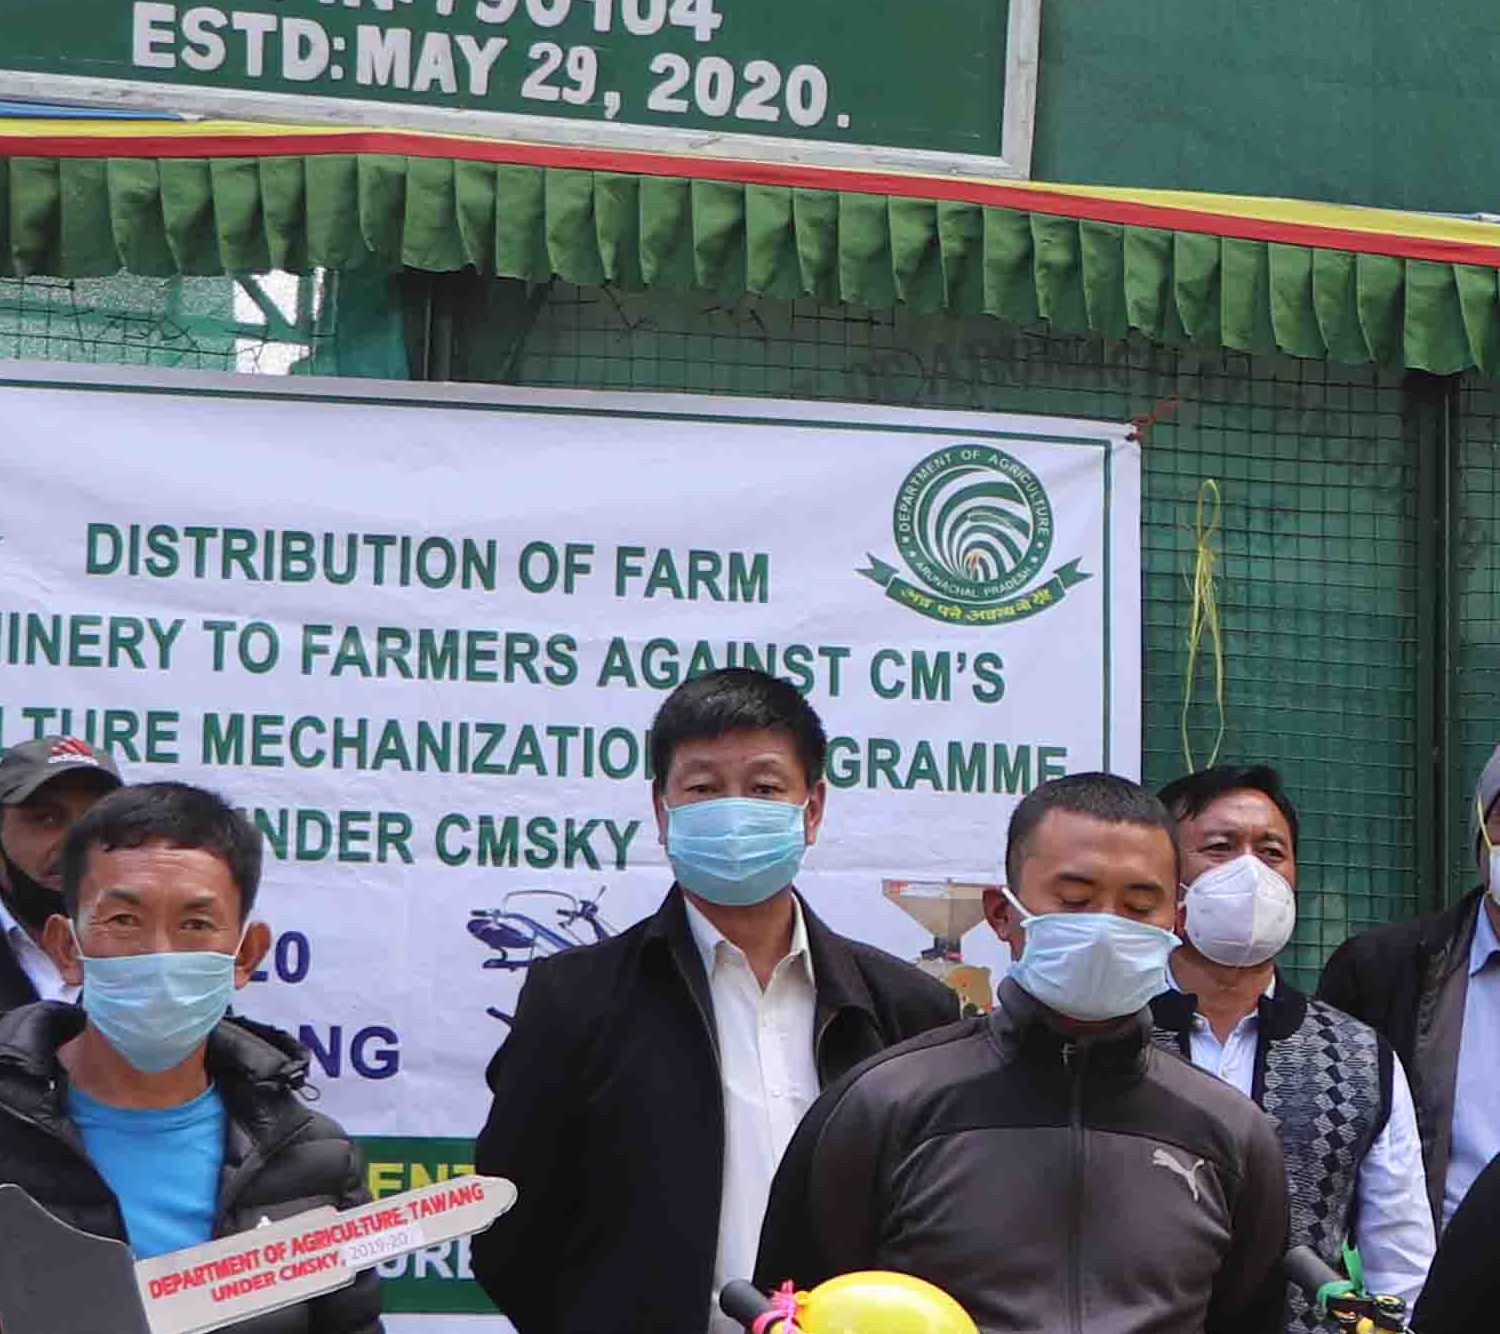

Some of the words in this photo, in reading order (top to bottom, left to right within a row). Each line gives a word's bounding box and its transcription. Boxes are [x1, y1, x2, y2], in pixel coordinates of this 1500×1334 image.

[525, 42, 620, 121] 29,
[647, 53, 851, 129] 2020.
[899, 452, 952, 532] DEPARTMENT
[961, 449, 981, 460] OF
[989, 453, 1049, 536] AGRICULTURE
[86, 522, 496, 590] DISTRIBUTION
[518, 540, 594, 594] OF
[615, 546, 769, 604] FARM
[915, 561, 979, 598] ARUNACHAL
[984, 566, 1031, 597] PRADESH
[203, 619, 280, 673] TO
[300, 624, 578, 685] FARMERS
[869, 649, 1005, 703] CM'S
[202, 712, 653, 780] MECHANIZATIO
[827, 737, 1067, 795] GRAMME
[258, 807, 414, 865] NDER
[435, 813, 642, 871] CMSKY
[149, 1248, 262, 1300] DEPARTMENT
[265, 1237, 287, 1265] OF
[409, 1182, 485, 1223] TAWANG
[211, 1270, 277, 1303] UNDER
